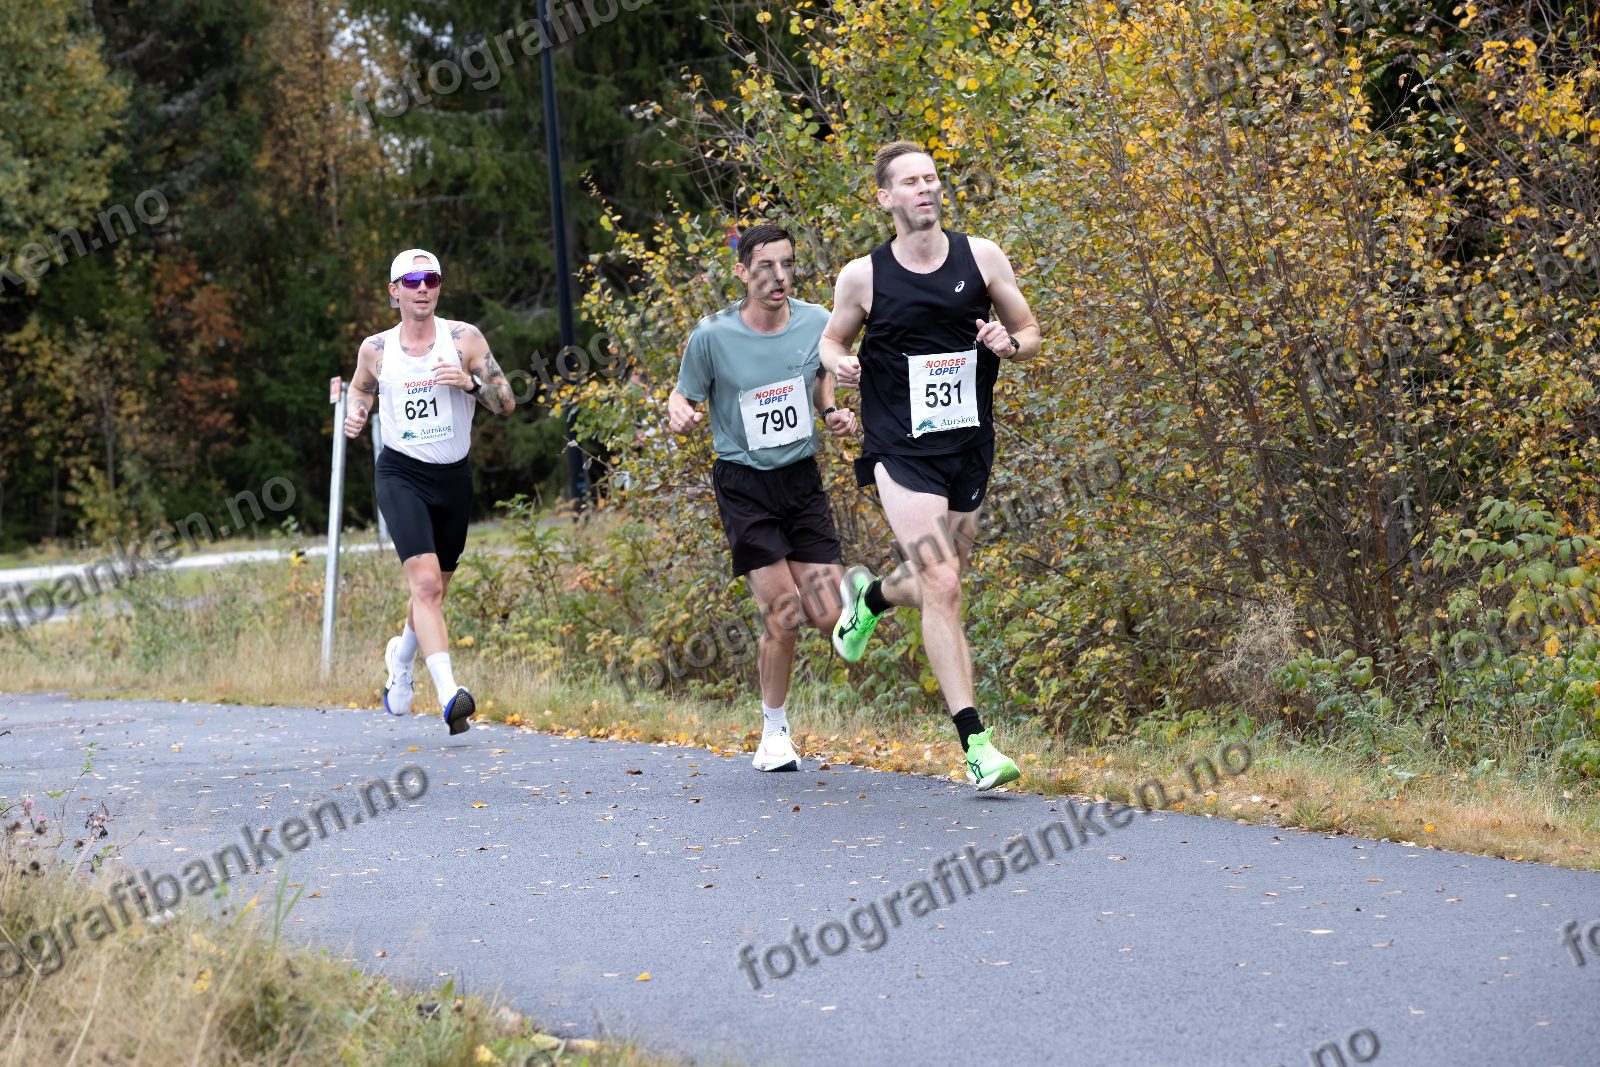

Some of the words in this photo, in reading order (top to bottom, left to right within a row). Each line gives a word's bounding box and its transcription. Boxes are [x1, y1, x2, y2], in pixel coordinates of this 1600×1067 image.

[924, 357, 967, 369] NORGES
[929, 366, 960, 376] LØPET
[753, 384, 794, 401] NORGES
[925, 379, 962, 408] 531
[759, 394, 788, 406] LØPET
[404, 396, 438, 420] 621
[755, 405, 798, 435] 790
[940, 415, 976, 427] Aurskog
